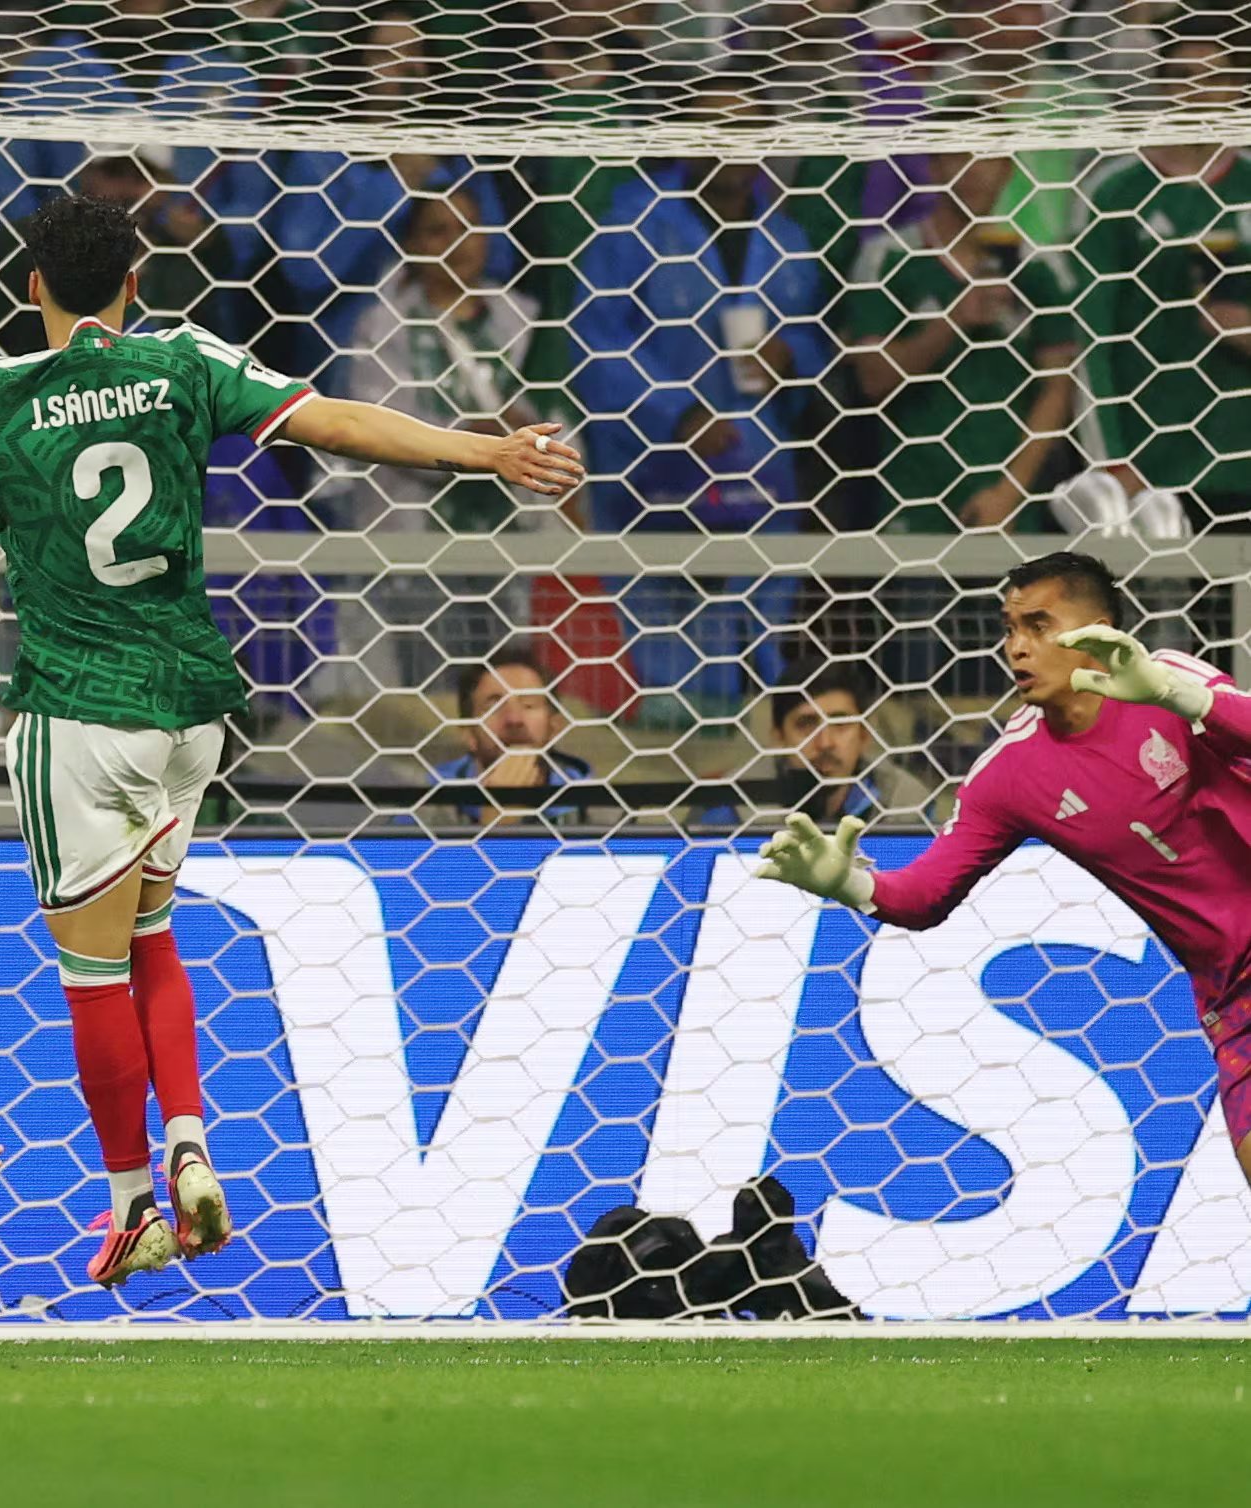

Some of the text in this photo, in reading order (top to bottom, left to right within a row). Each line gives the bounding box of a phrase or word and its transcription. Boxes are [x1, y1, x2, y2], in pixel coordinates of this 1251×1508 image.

[31, 378, 173, 431] J.SÁNCHEZ
[72, 441, 169, 587] 2
[1129, 821, 1179, 862] 1
[175, 845, 1251, 1319] VIS
